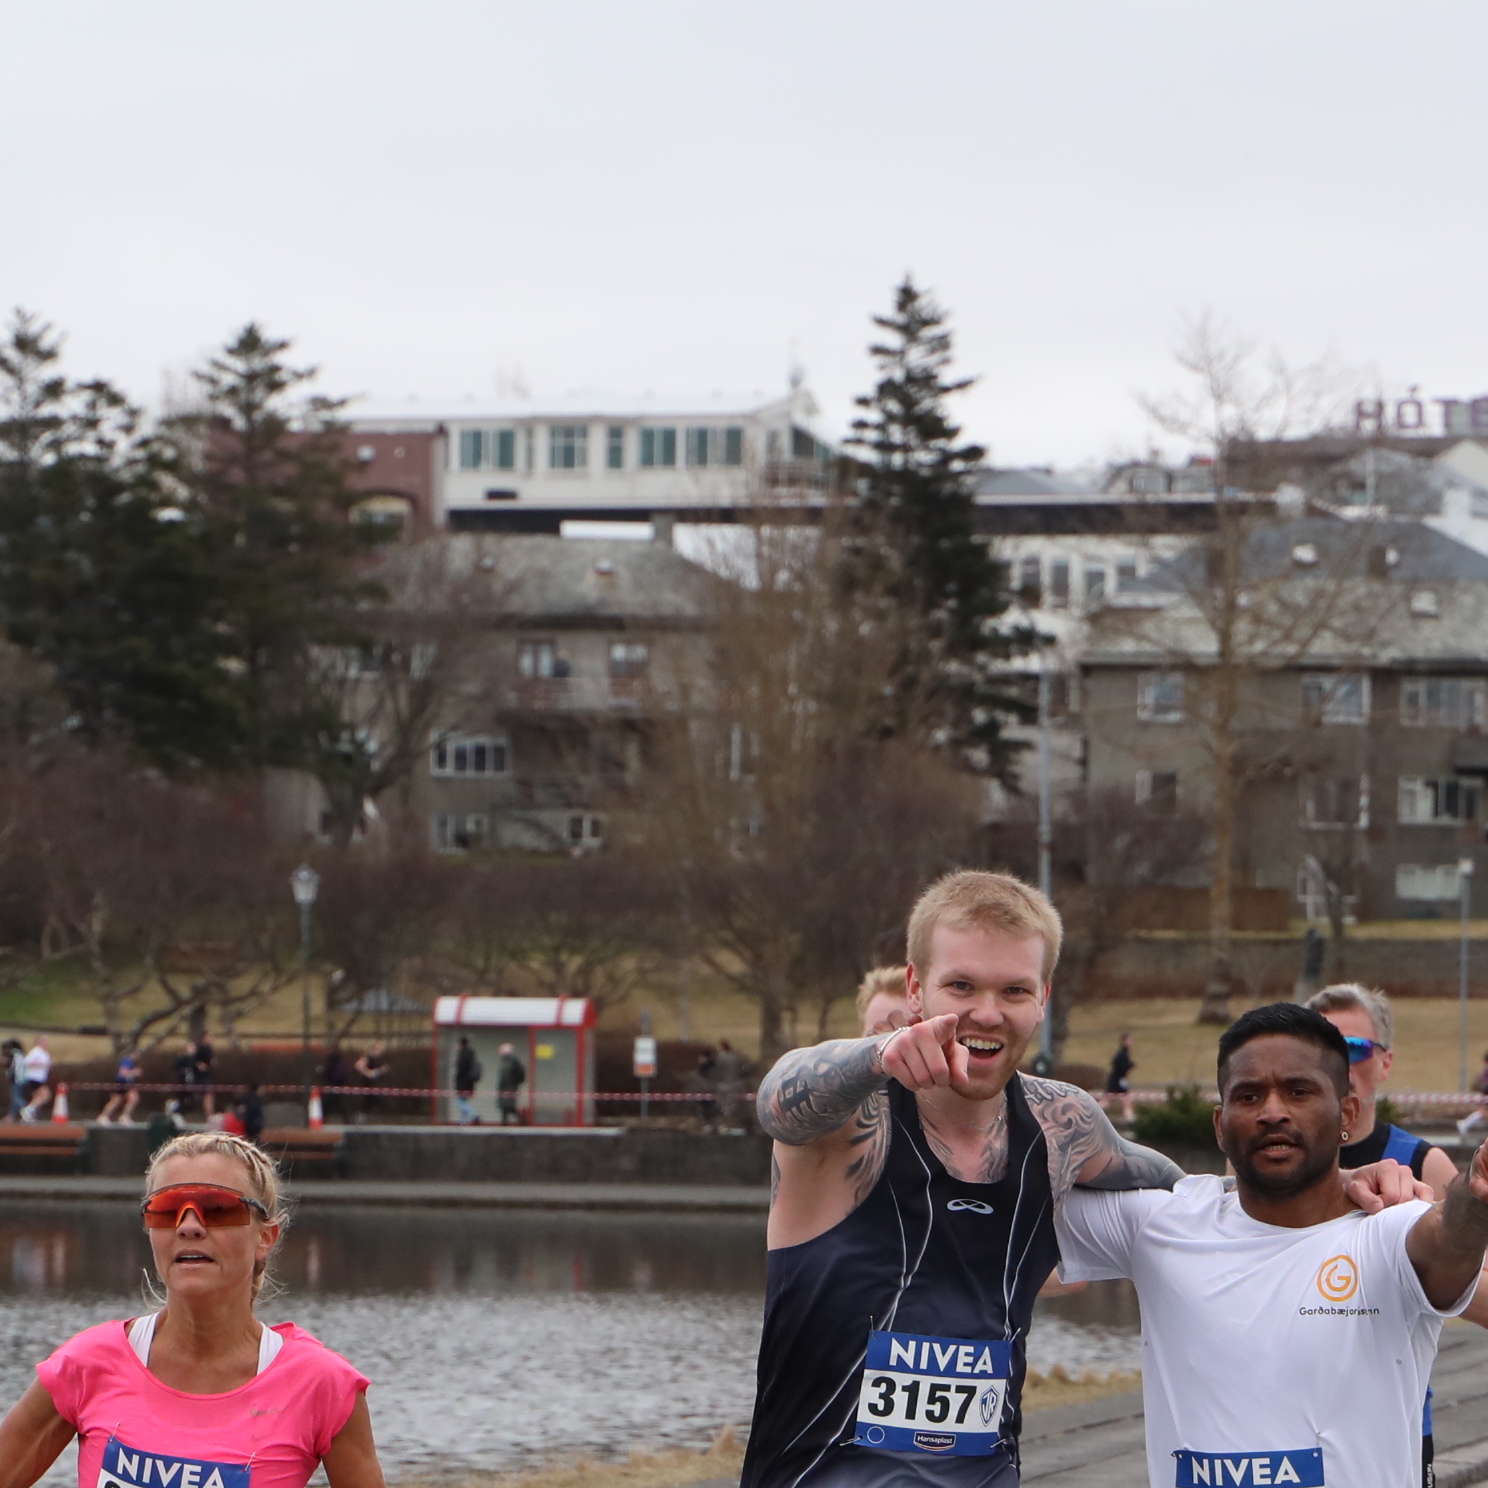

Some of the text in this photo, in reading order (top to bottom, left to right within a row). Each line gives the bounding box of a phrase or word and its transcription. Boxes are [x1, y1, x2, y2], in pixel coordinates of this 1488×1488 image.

[888, 1337, 994, 1374] NIVEA
[867, 1376, 977, 1424] 3157
[917, 1434, 953, 1445] Hansaplast
[1191, 1455, 1301, 1487] NIVEA
